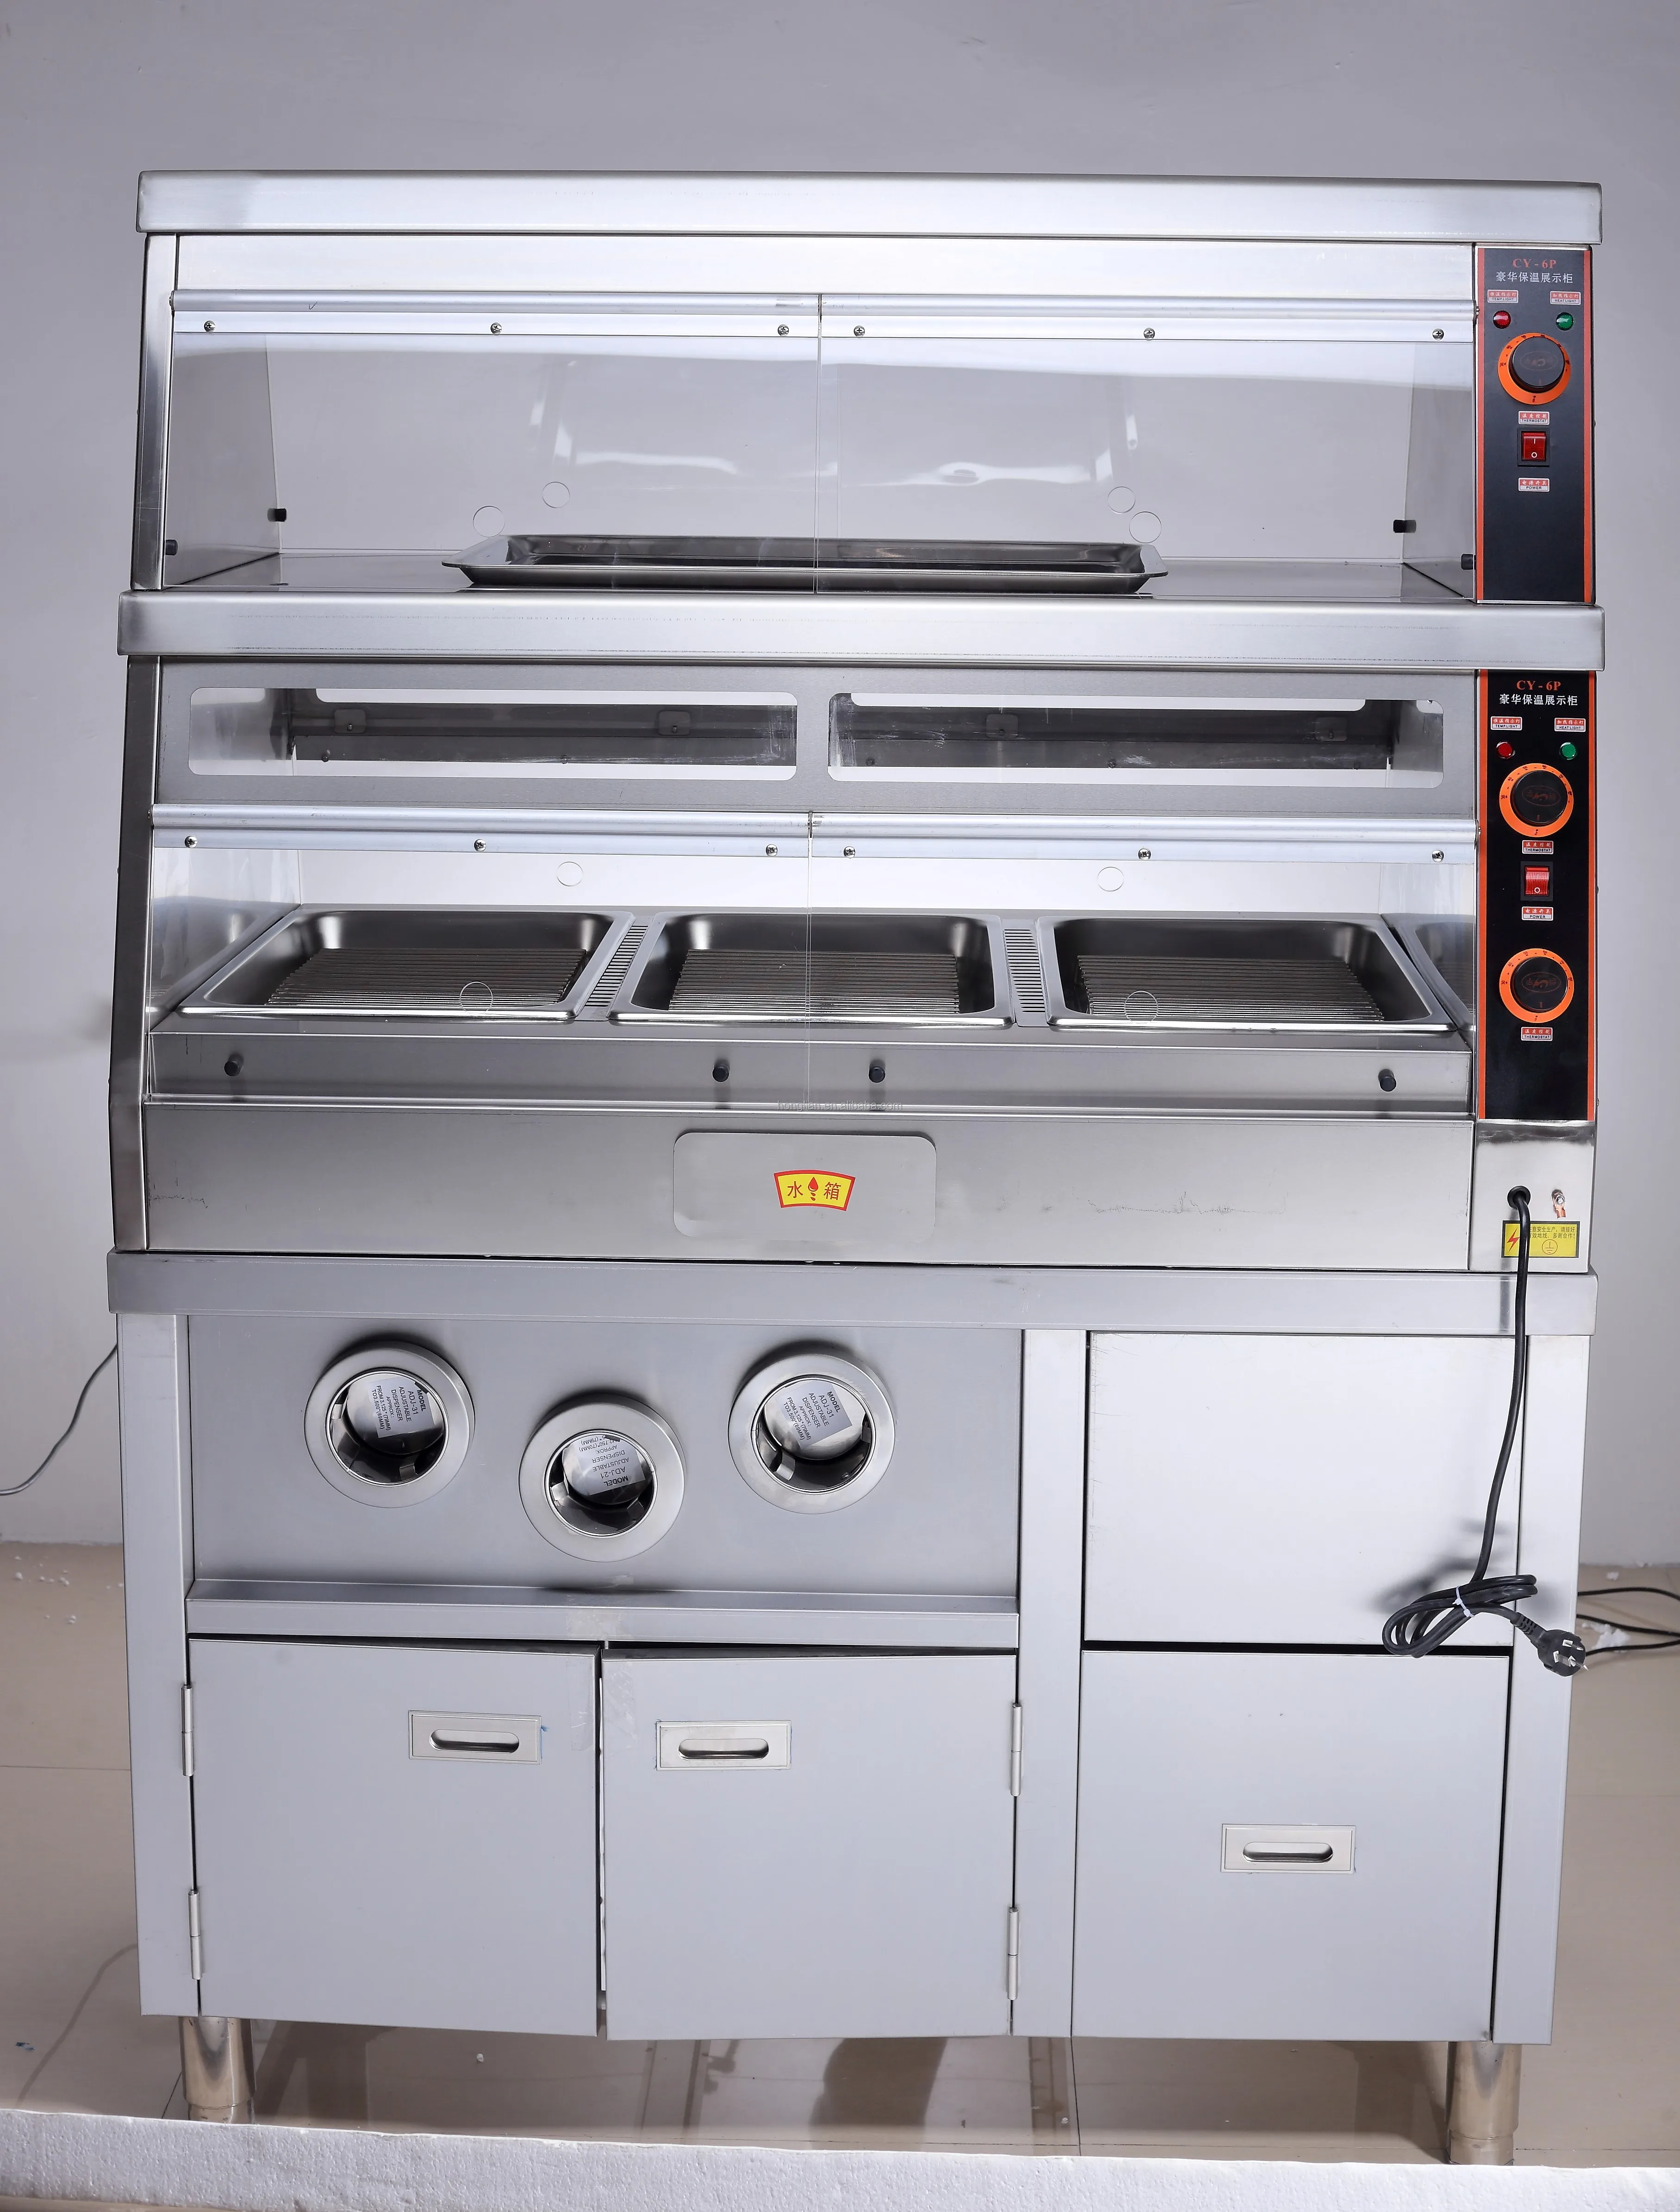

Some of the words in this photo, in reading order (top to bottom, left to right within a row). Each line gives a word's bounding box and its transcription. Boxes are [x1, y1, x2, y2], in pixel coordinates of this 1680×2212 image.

[1496, 271, 1574, 284] 豪华保温展示柜
[1499, 693, 1578, 706] 豪华保温展示柜
[391, 1389, 403, 1421] DISPENSER
[398, 1386, 412, 1421] ADJUSTABLE
[408, 1390, 418, 1414] ADJ-31
[417, 1390, 427, 1412] MODEL
[787, 1397, 796, 1412] FROM
[809, 1392, 829, 1427] ADJUSTABLE
[818, 1394, 834, 1418] ADJ-31
[827, 1391, 841, 1413] MODEL
[802, 1397, 821, 1428] DISPENSER
[591, 1450, 625, 1463] DISPENSER
[592, 1457, 629, 1472] ADJUSTABLE
[600, 1466, 626, 1479] ADJ-21
[604, 1476, 628, 1487] MODEL
